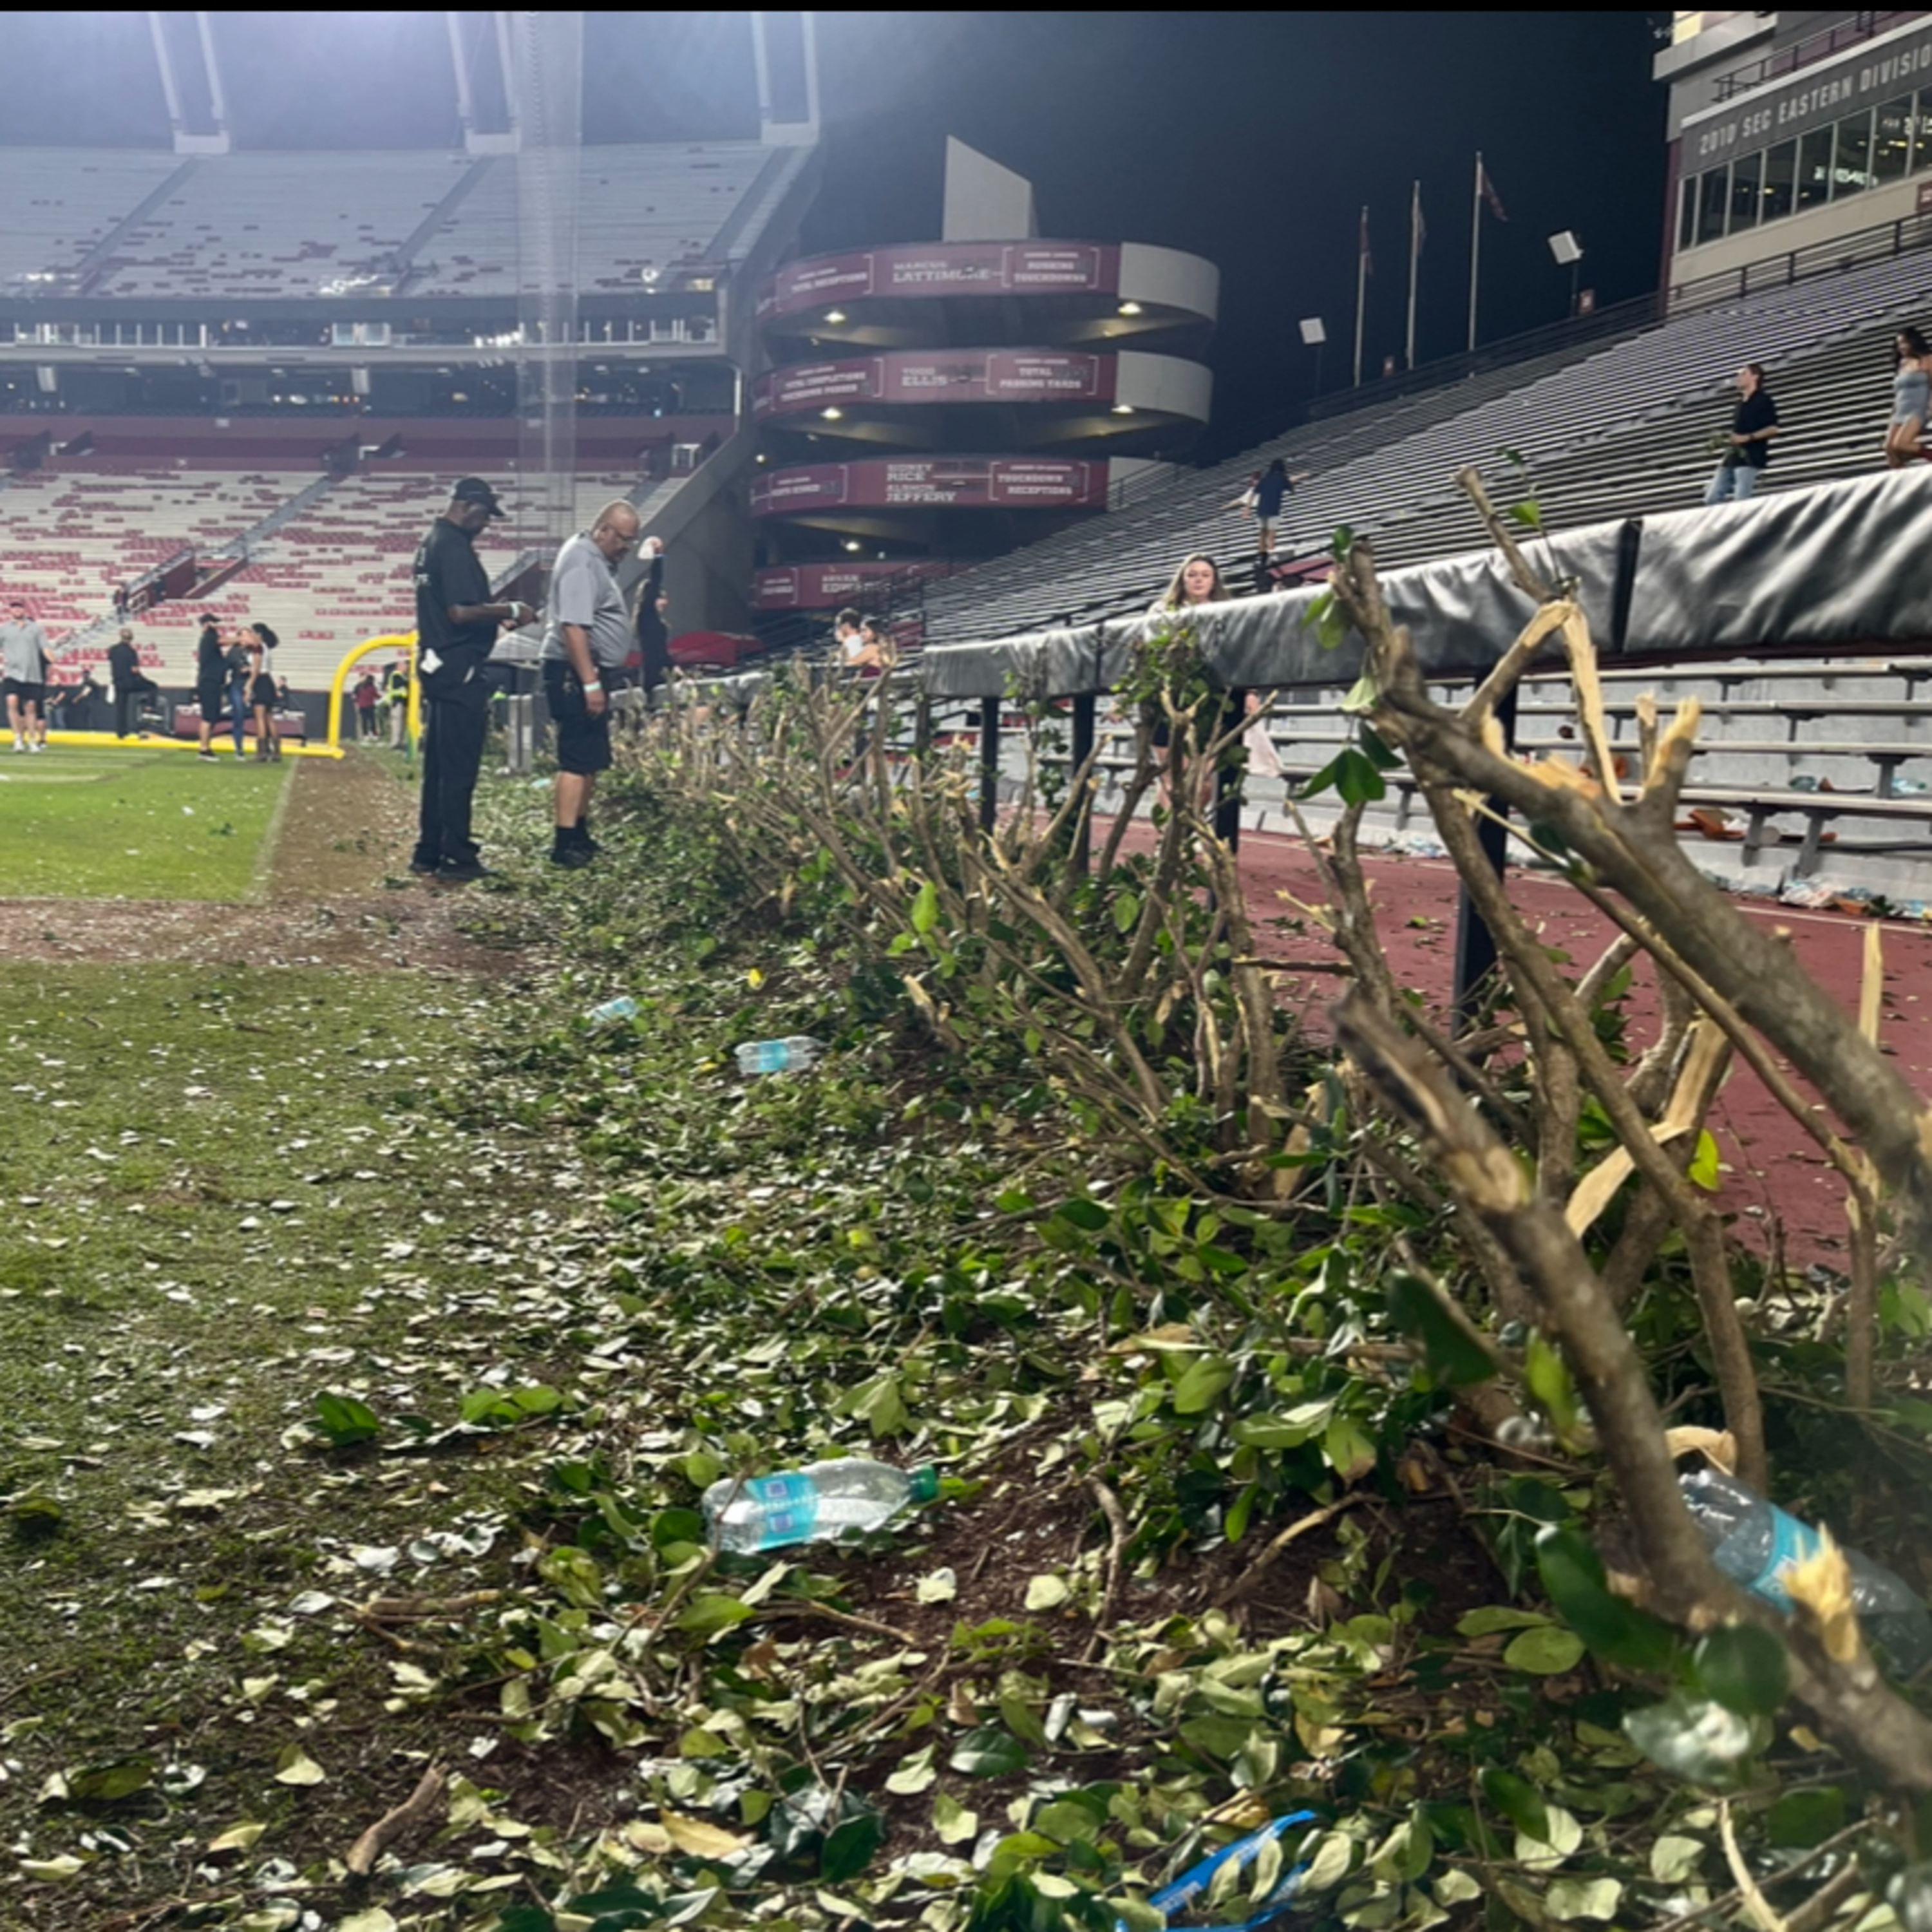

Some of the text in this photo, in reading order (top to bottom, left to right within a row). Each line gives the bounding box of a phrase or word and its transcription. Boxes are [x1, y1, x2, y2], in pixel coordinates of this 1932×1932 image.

[1700, 123, 1737, 155] 2010
[1742, 109, 1771, 138] SEC
[1778, 76, 1853, 124] EASTERN
[893, 261, 949, 270] MARCUS
[902, 375, 949, 387] ELLIS
[886, 463, 933, 472] SIDNEY
[886, 472, 926, 482] RICE
[885, 491, 957, 502] JEFFERY
